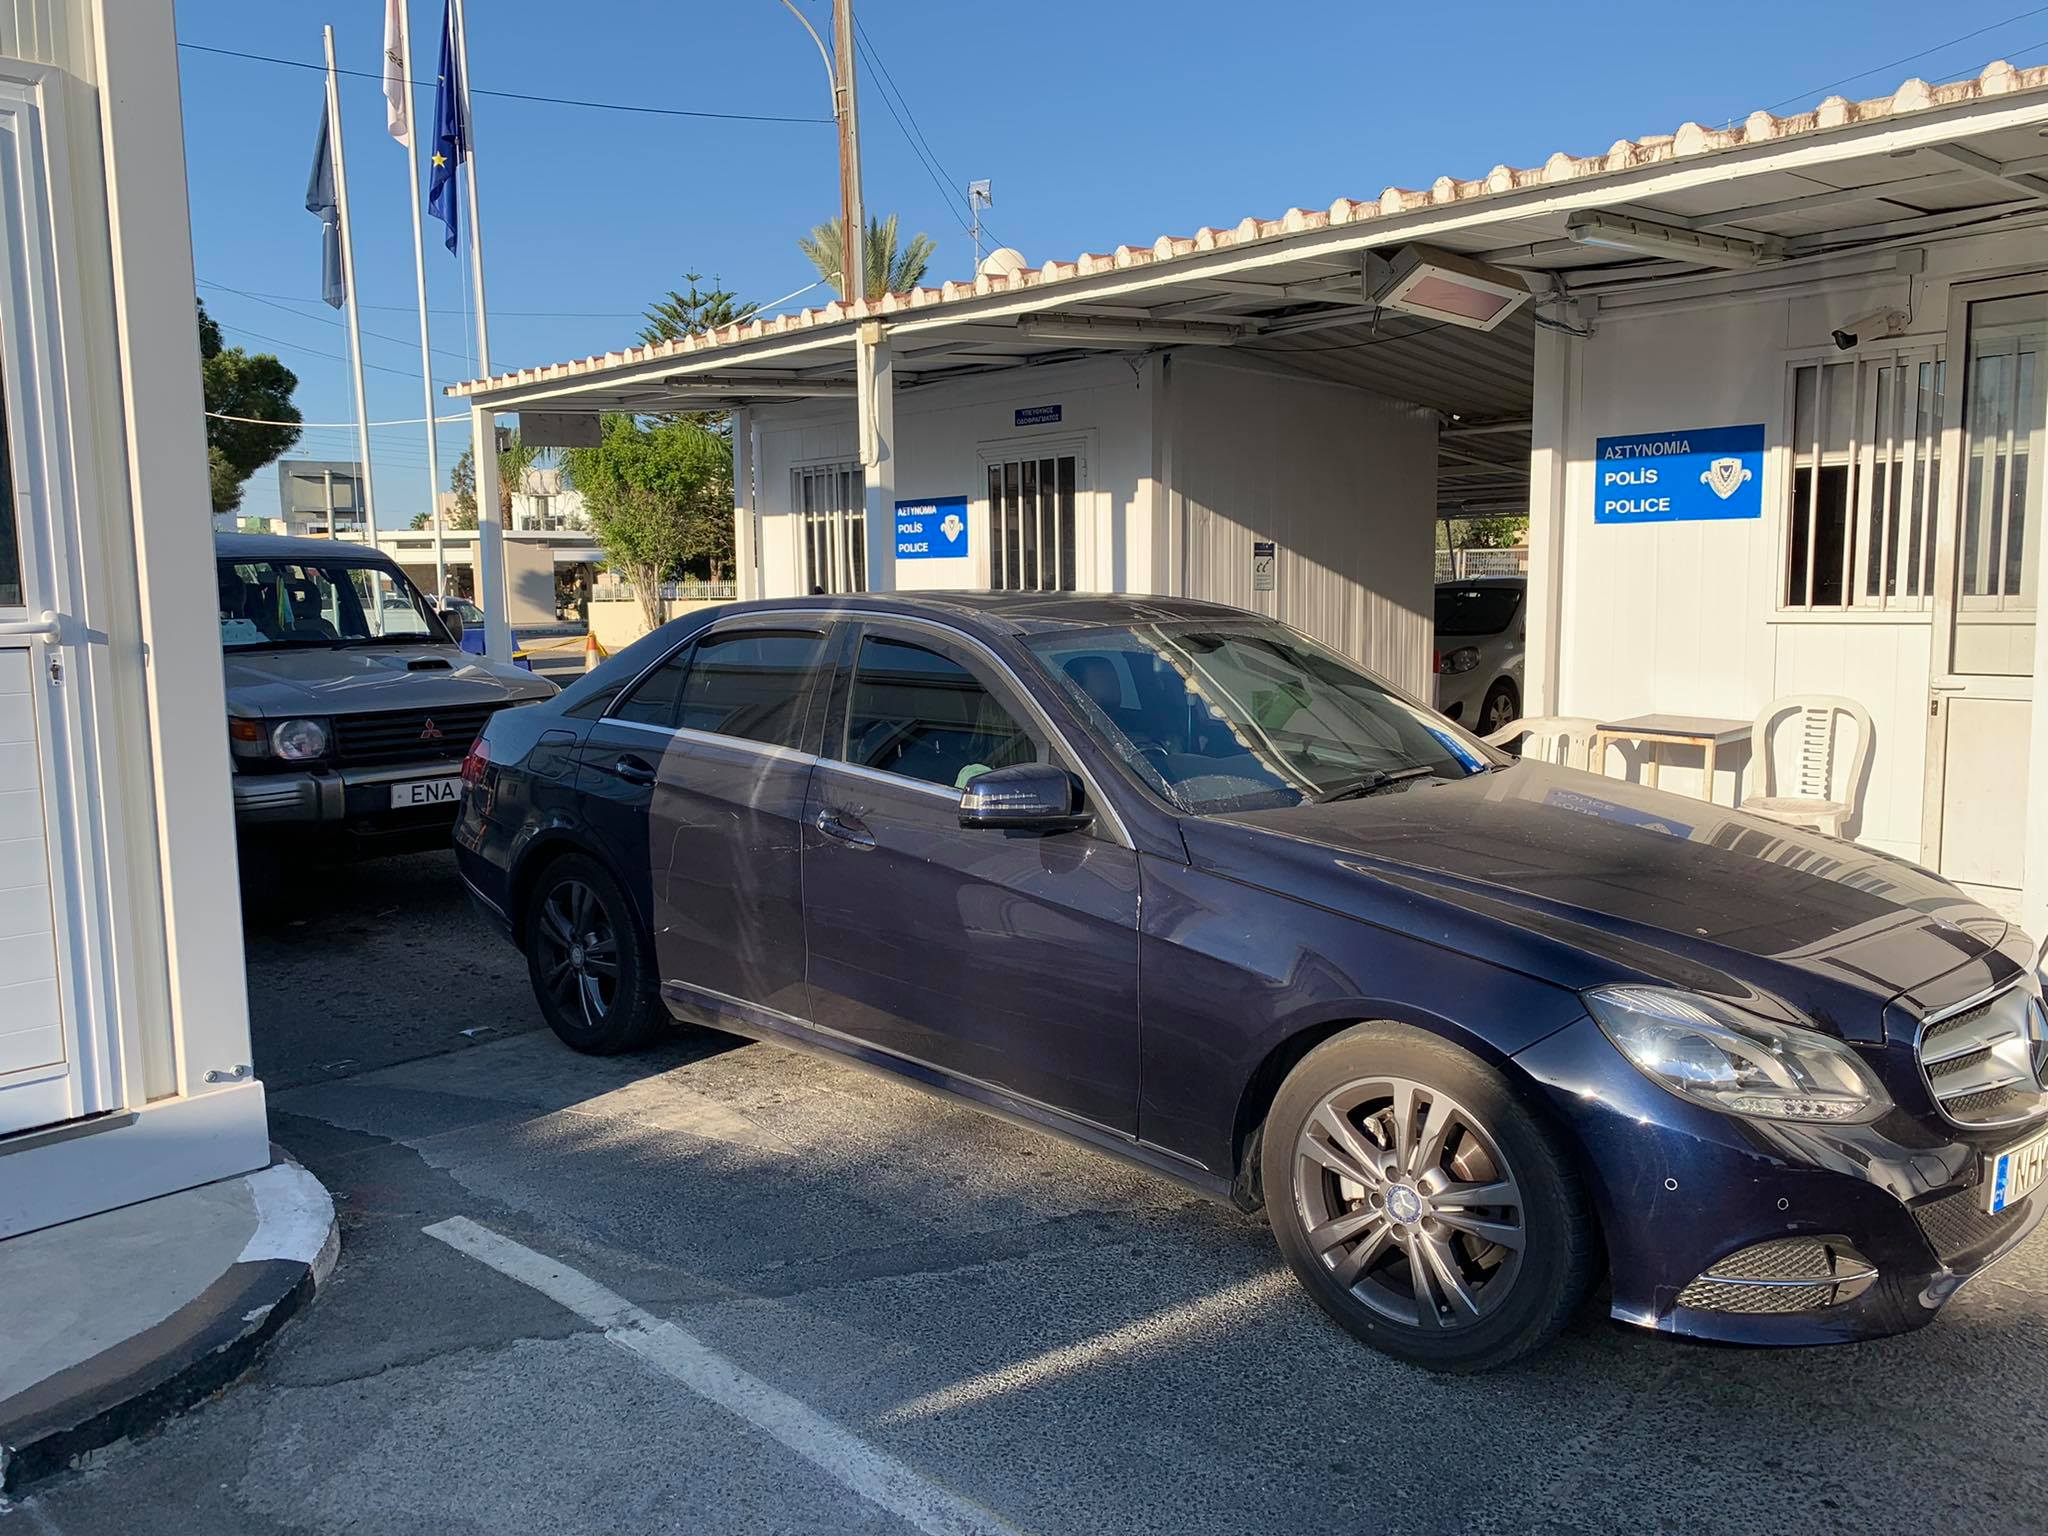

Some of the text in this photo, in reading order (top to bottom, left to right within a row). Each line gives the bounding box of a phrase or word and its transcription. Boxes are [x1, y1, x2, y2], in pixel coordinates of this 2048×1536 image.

[1604, 439, 1691, 460] ΑΣΤΥΝΟΜΙΑ
[897, 504, 937, 517] ΑΣΤΥΝΟΜΙΑ
[1604, 497, 1671, 514] POLICE
[898, 542, 929, 553] POLICE
[411, 781, 455, 804] ENA
